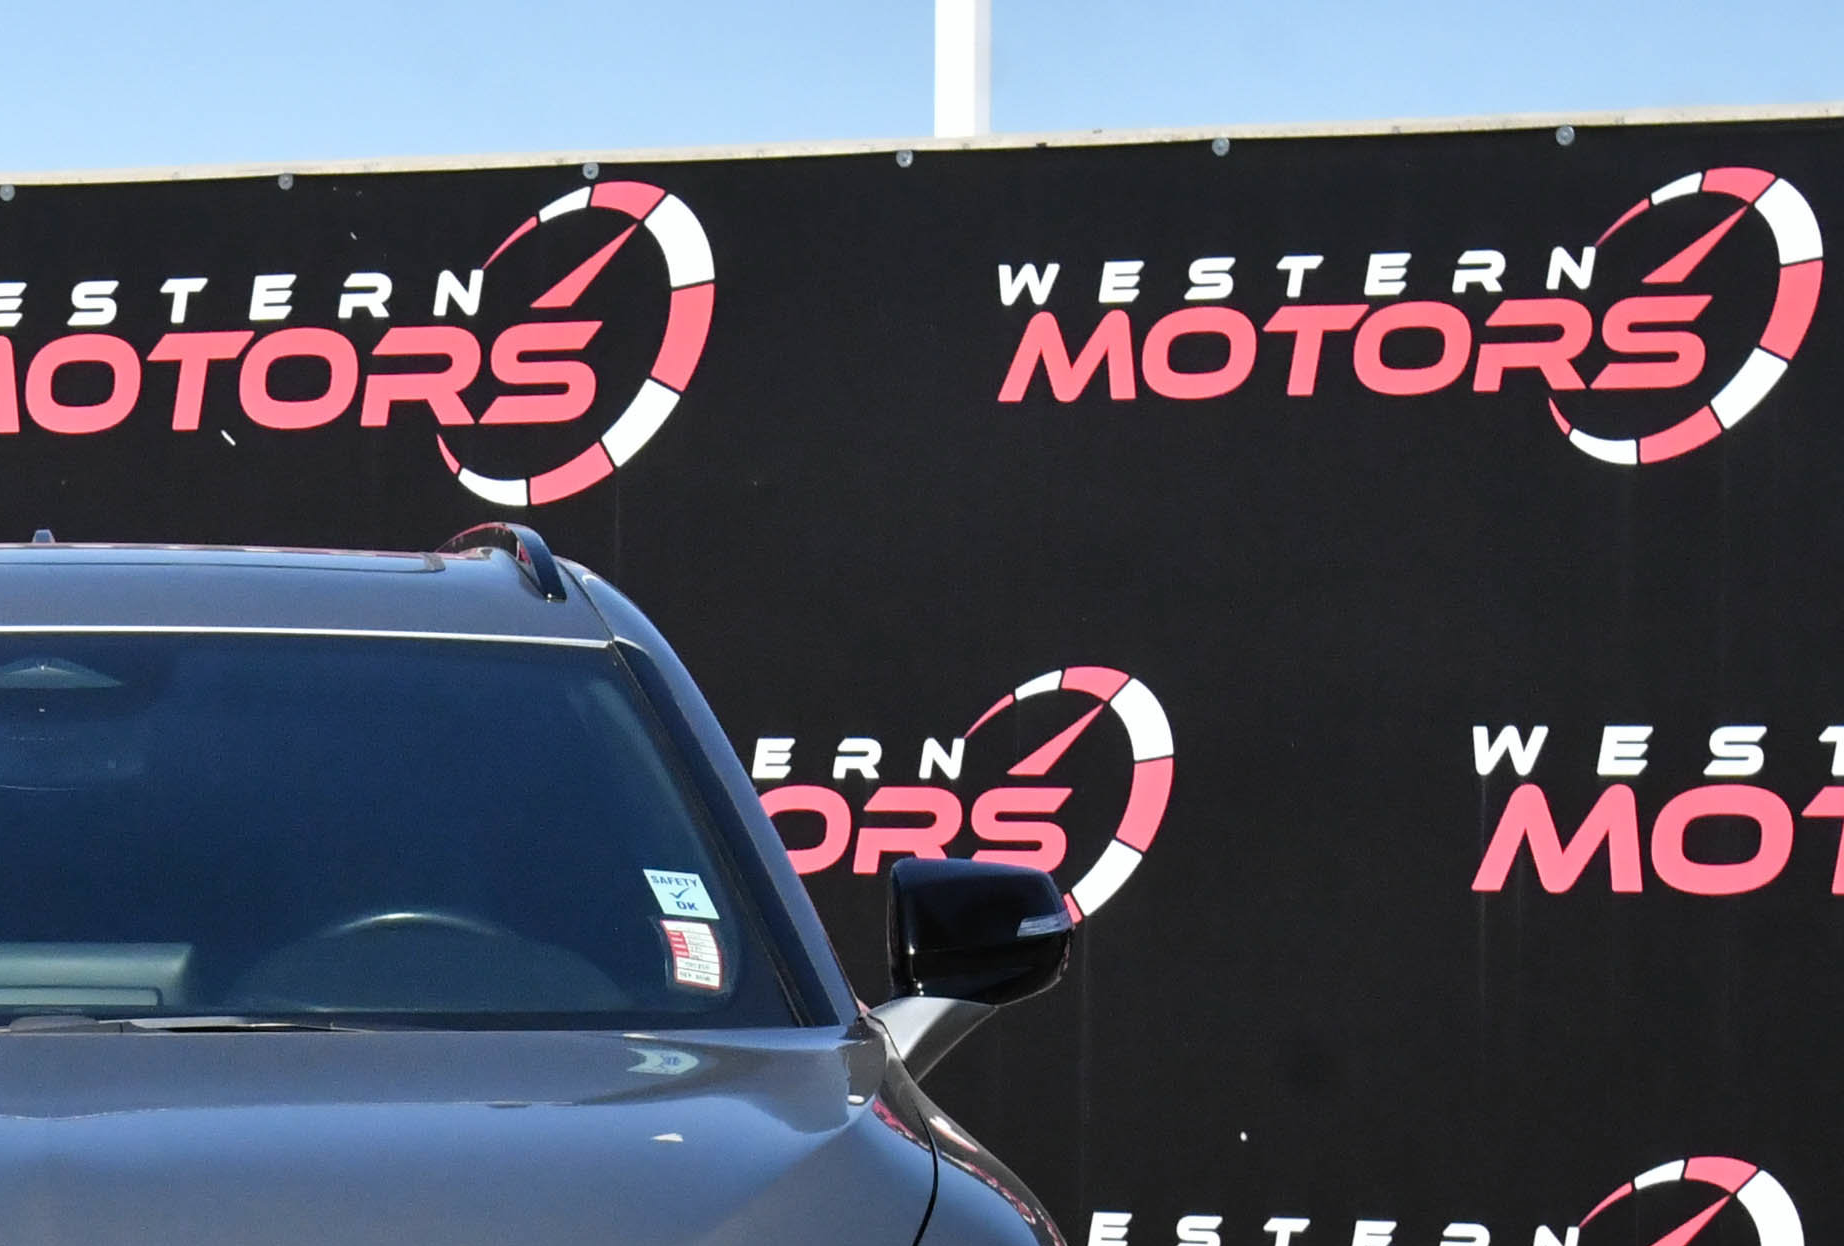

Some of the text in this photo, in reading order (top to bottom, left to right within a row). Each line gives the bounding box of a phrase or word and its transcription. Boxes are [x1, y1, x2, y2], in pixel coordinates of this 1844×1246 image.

[998, 246, 1597, 306] WESTERN
[997, 294, 1713, 403] MOTORS
[751, 737, 965, 780] ERN
[650, 874, 698, 887] SAFETY
[675, 900, 699, 911] OK
